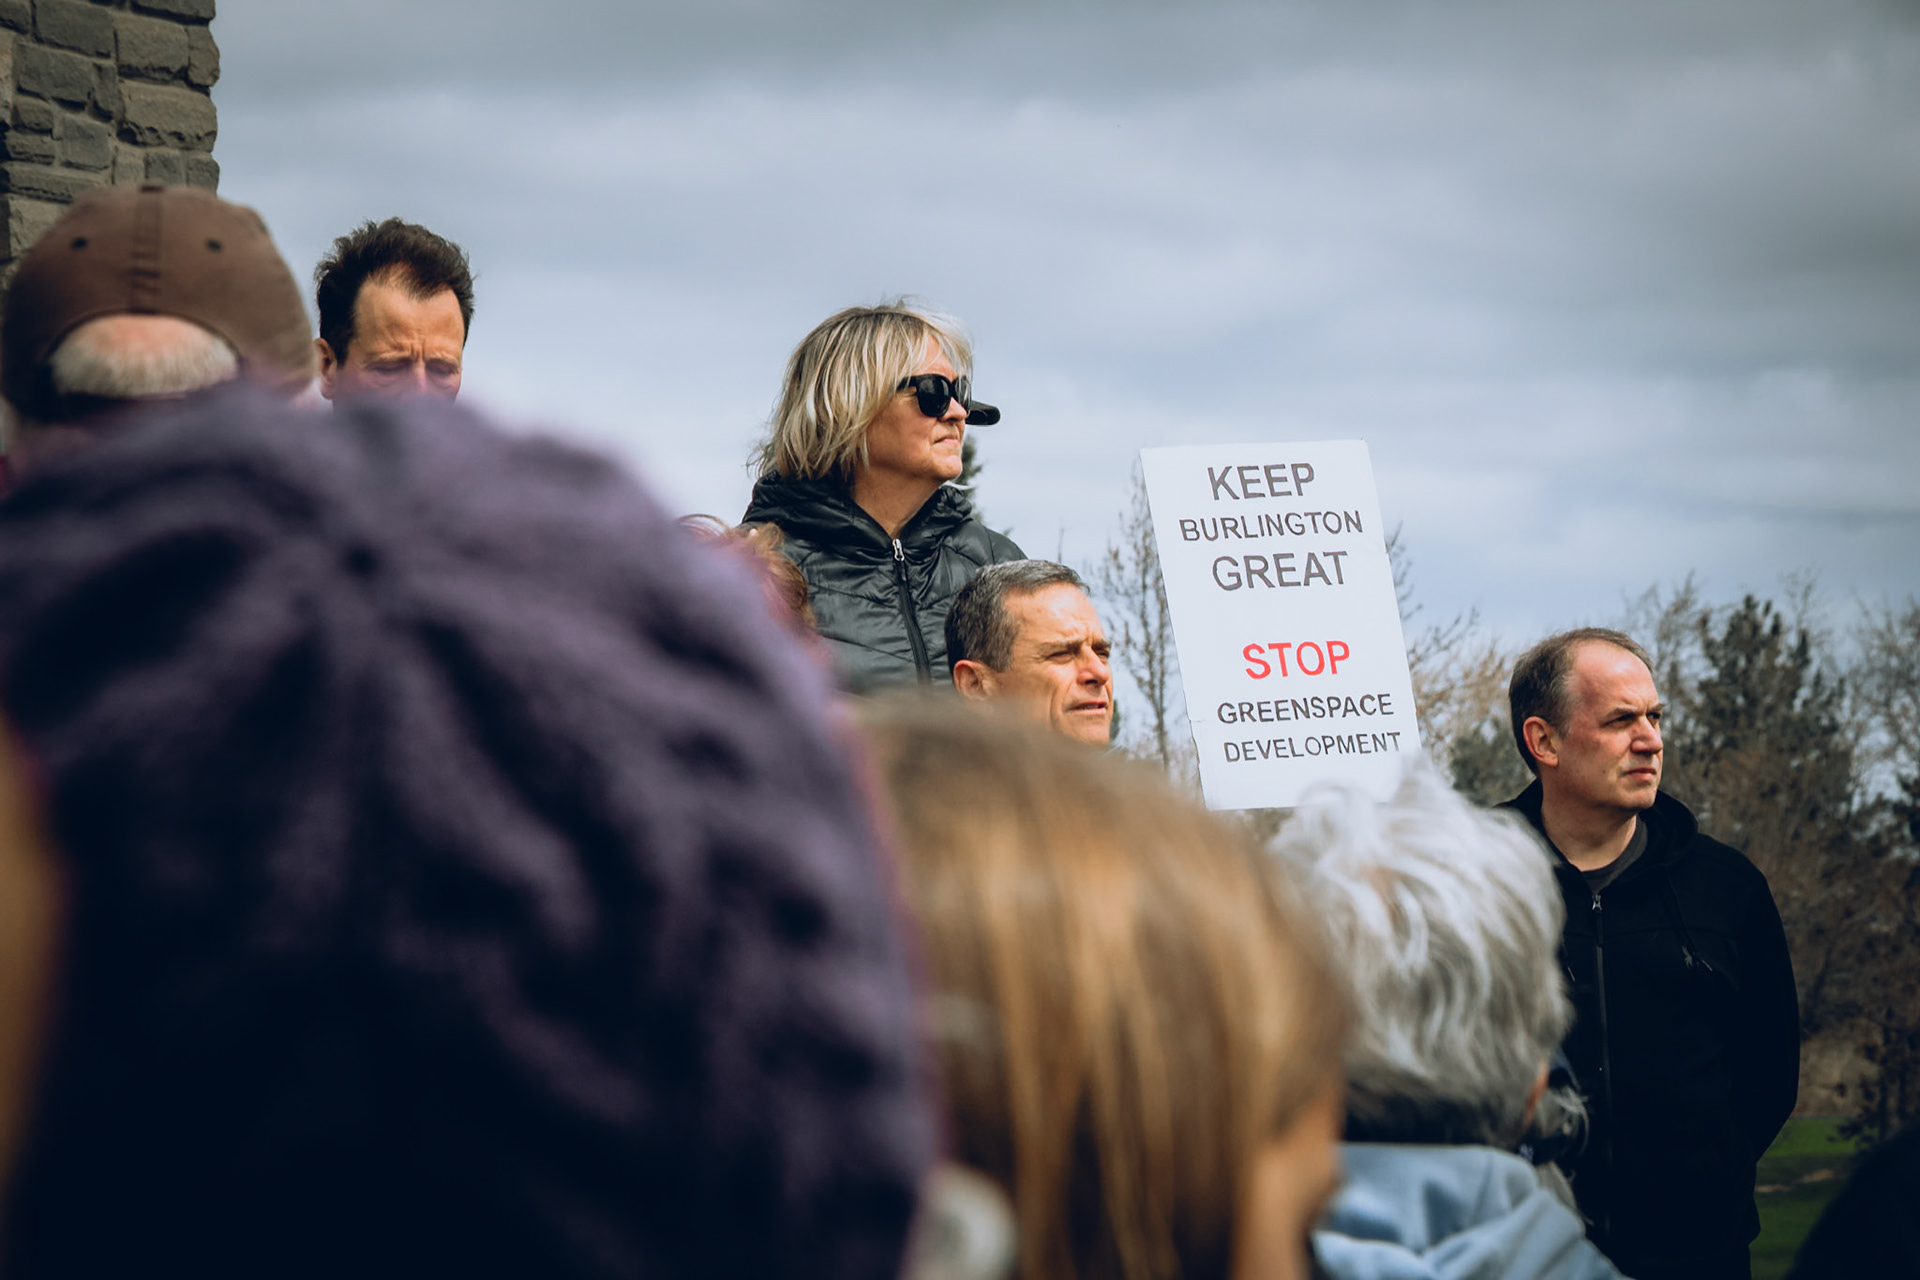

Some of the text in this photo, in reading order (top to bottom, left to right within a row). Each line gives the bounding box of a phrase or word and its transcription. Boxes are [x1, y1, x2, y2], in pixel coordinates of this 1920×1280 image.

[1207, 463, 1315, 500] KEEP
[1178, 510, 1363, 542] BURLINGTON
[1212, 551, 1348, 591] GREAT
[1242, 640, 1350, 680] STOP
[1217, 693, 1395, 724] GREENSPACE
[1223, 731, 1401, 763] DEVELOPMENT
